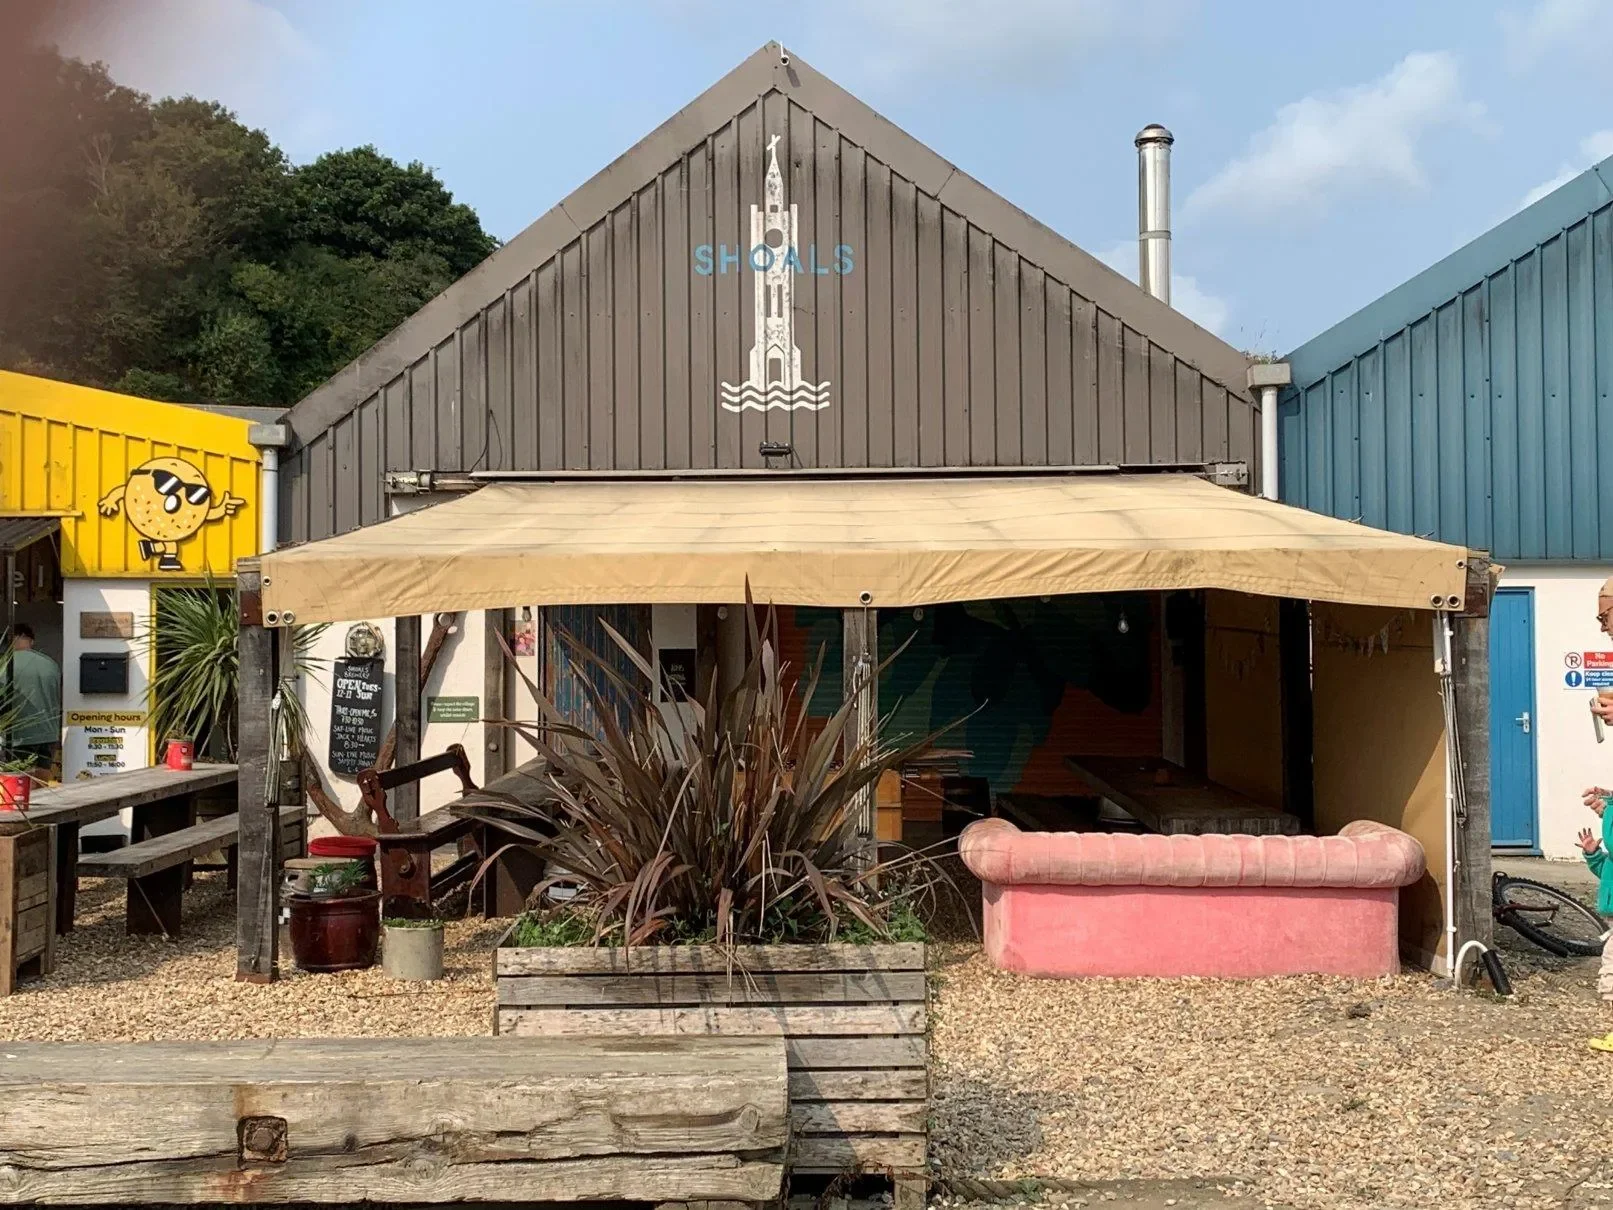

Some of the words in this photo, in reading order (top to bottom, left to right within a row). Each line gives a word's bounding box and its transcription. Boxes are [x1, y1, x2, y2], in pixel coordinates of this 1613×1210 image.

[694, 243, 855, 275] SHOALS
[1594, 652, 1606, 660] No
[336, 678, 362, 691] OPEN
[355, 690, 373, 700] SUN
[71, 713, 113, 723] Opening
[114, 713, 141, 721] hours
